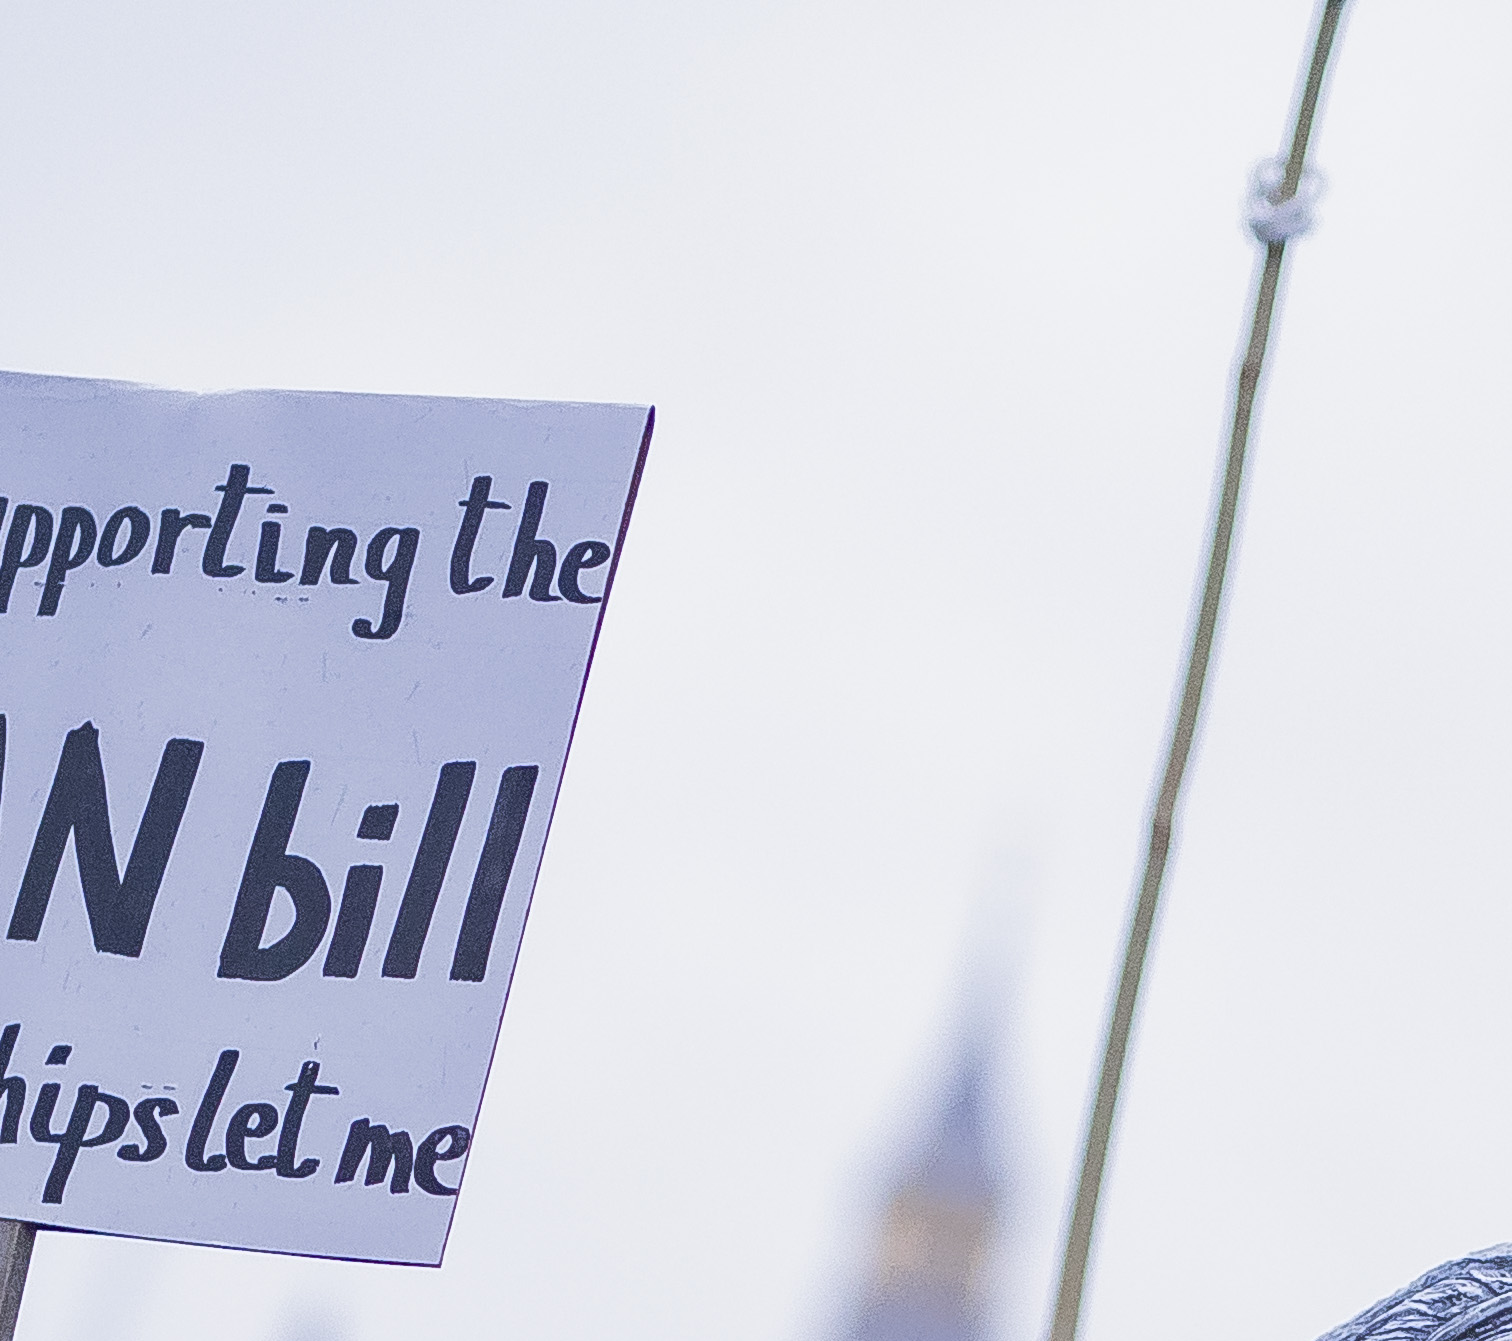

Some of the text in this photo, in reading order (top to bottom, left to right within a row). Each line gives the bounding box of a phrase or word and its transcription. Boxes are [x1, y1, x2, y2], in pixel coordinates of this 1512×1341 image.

[449, 474, 611, 605] the
[216, 759, 540, 983] bill
[184, 1048, 341, 1180] let
[333, 1116, 471, 1196] me
